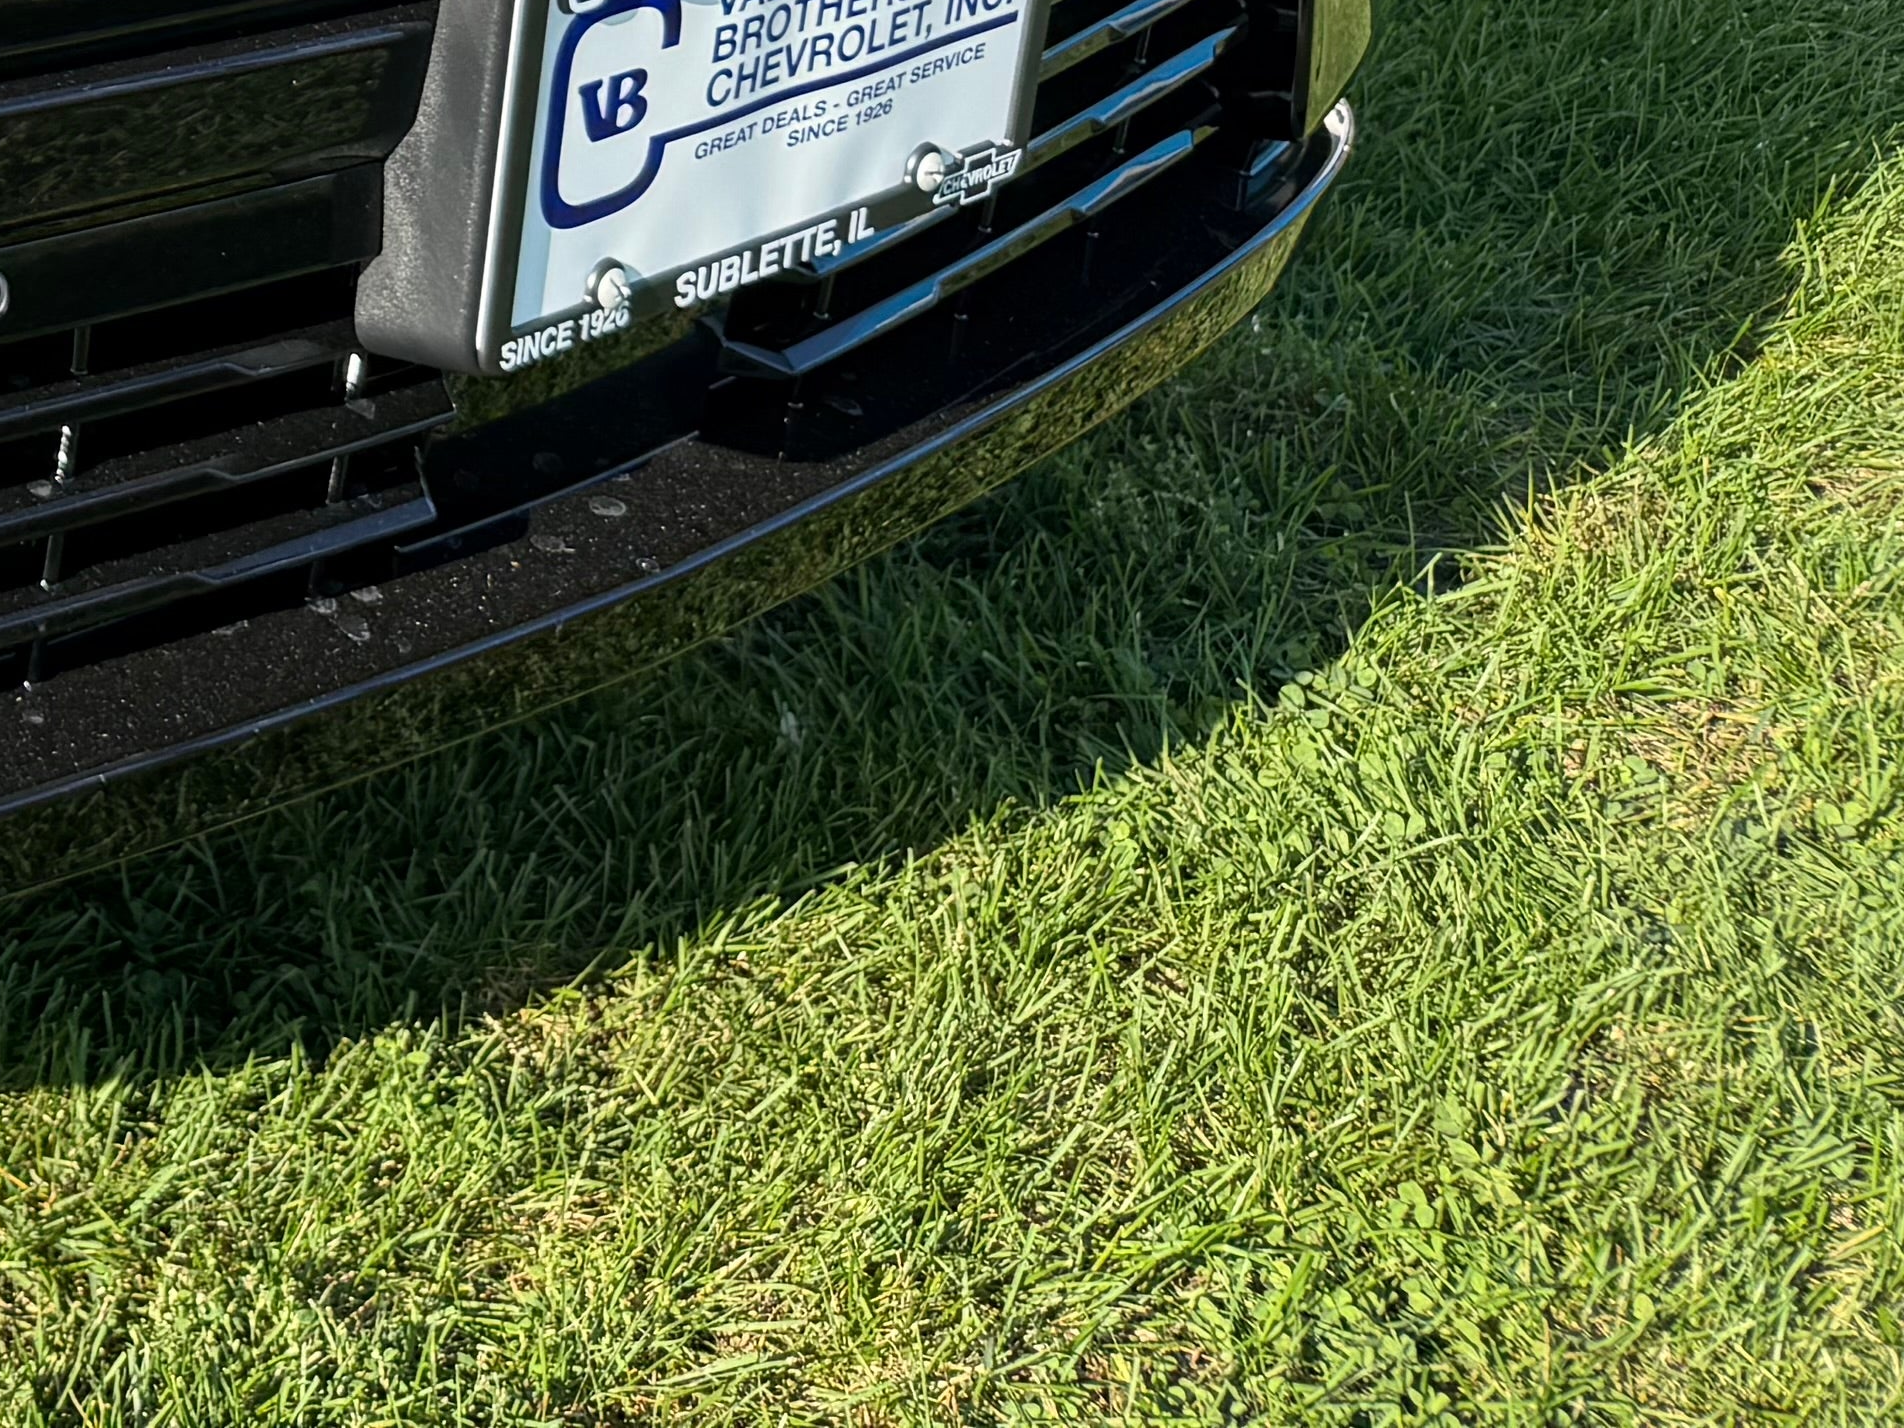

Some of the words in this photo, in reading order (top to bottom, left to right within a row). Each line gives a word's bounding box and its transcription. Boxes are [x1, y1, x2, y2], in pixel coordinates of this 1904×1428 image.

[578, 68, 648, 142] VB
[694, 122, 758, 160] GREAT
[761, 100, 827, 135] DEALS
[846, 72, 907, 108] GREAT
[909, 42, 986, 84] SERVICE
[786, 114, 848, 147] SINCE
[855, 98, 893, 126] 1926
[943, 155, 1014, 195] CHEVROLET
[674, 218, 842, 309] SUBLETTE,
[848, 207, 875, 244] IL
[499, 320, 575, 372] SINCE
[578, 300, 632, 342] 1926
